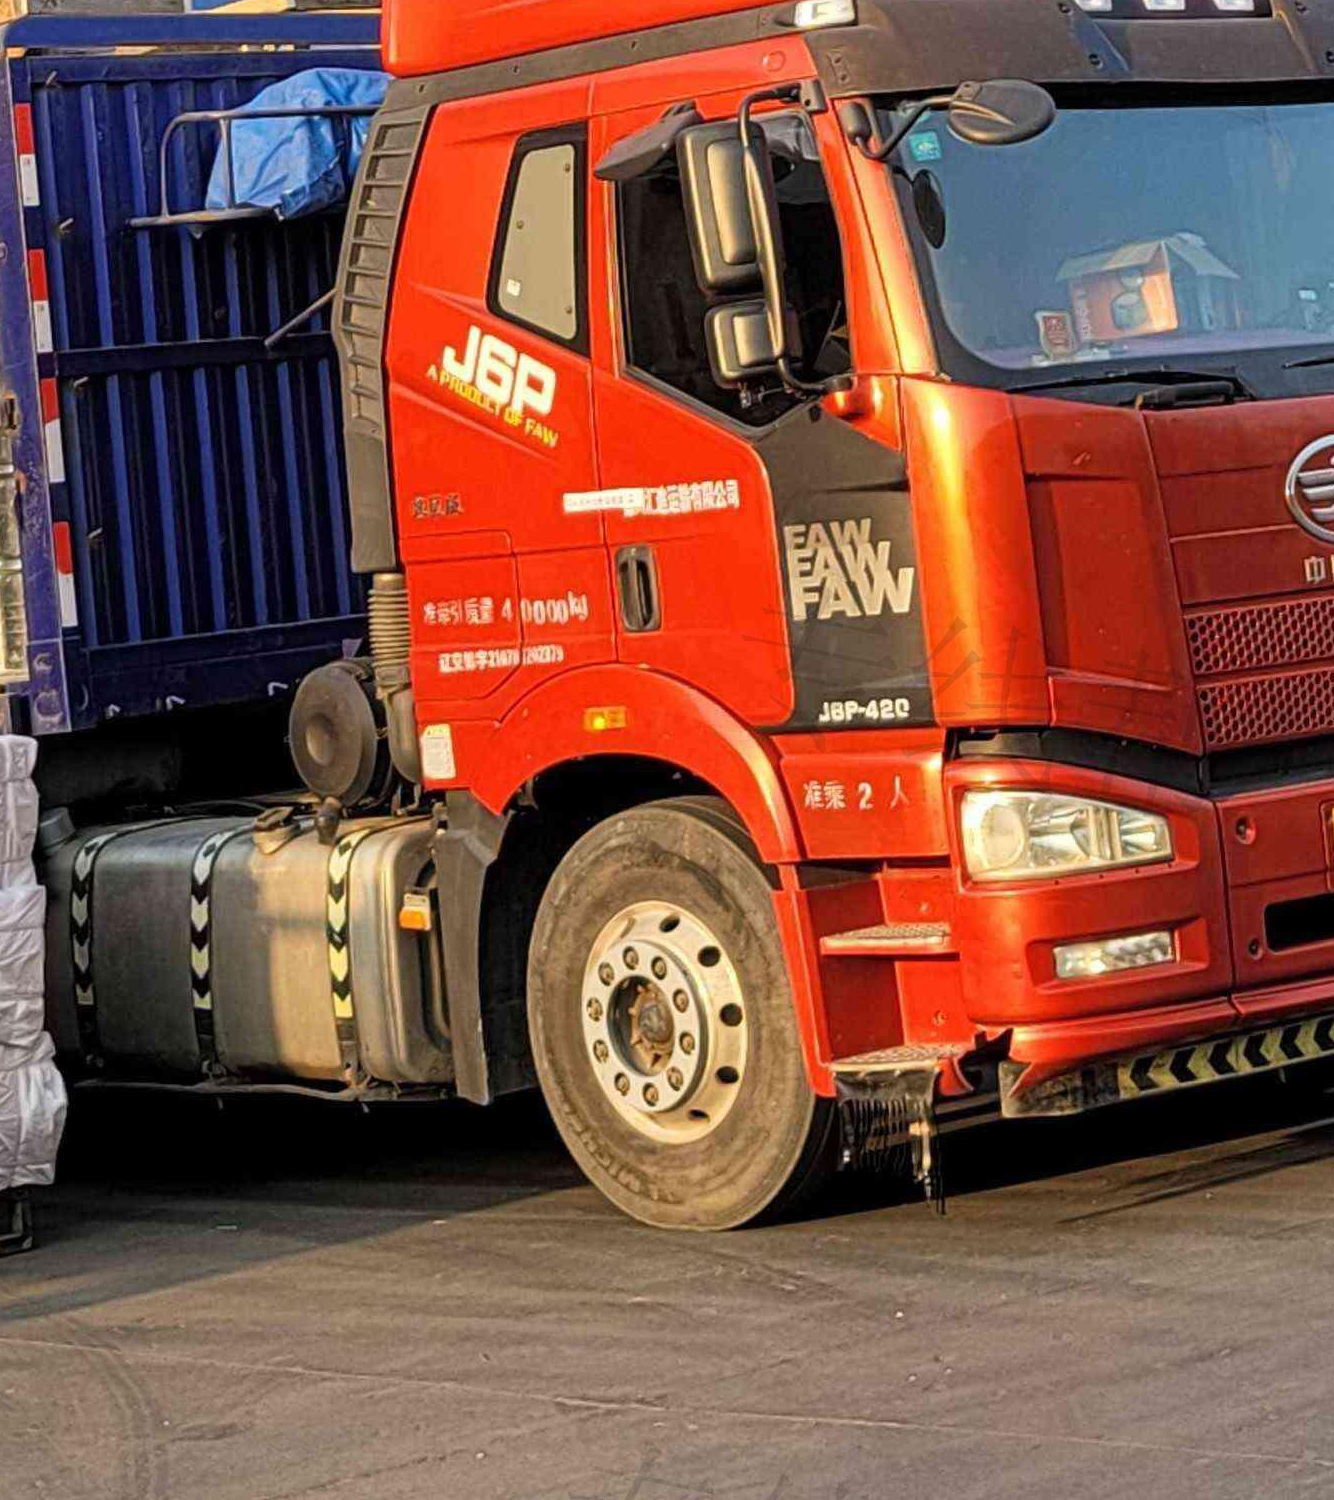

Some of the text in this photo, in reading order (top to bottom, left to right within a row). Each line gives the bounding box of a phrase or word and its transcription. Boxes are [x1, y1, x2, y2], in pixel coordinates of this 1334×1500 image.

[442, 324, 556, 417] J6P
[525, 417, 559, 448] FAW
[787, 541, 891, 585] FAW
[791, 567, 914, 621] FAW
[858, 782, 873, 809] 2
[891, 775, 910, 808] 人
